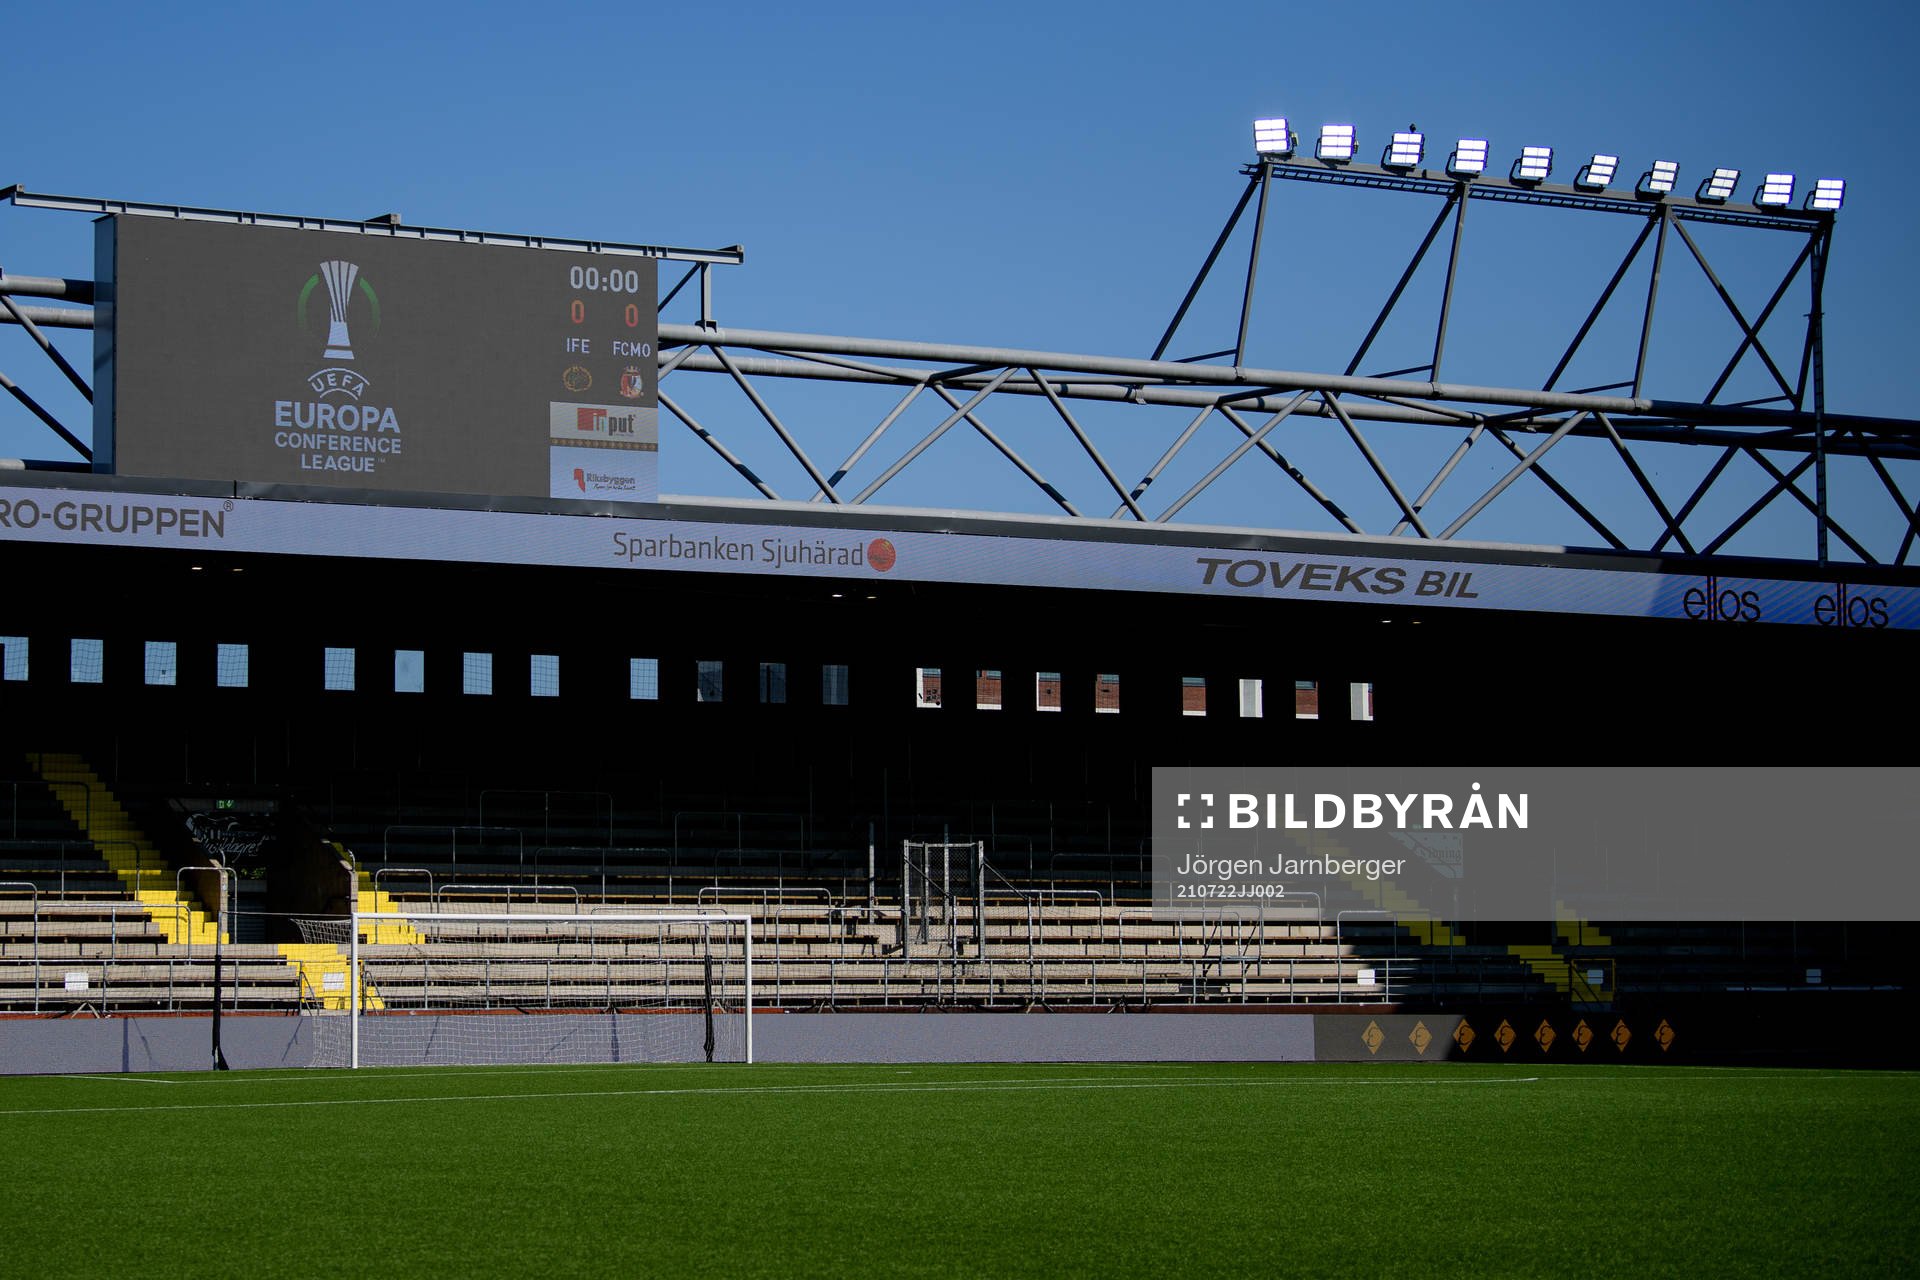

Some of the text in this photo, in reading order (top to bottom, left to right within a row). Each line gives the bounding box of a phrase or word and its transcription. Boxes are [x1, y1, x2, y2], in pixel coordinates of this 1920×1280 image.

[570, 265, 639, 294] 00:00
[571, 299, 639, 328] 0 0
[566, 337, 651, 358] IFE FCMO
[311, 373, 365, 397] UEFA
[275, 400, 401, 433] EUROPA
[275, 431, 402, 454] CONFERENCE
[613, 532, 864, 569] Sparbanken Sjuhärad
[1196, 557, 1479, 599] TOVEKS BIL
[1683, 575, 1889, 630] ellos ellos
